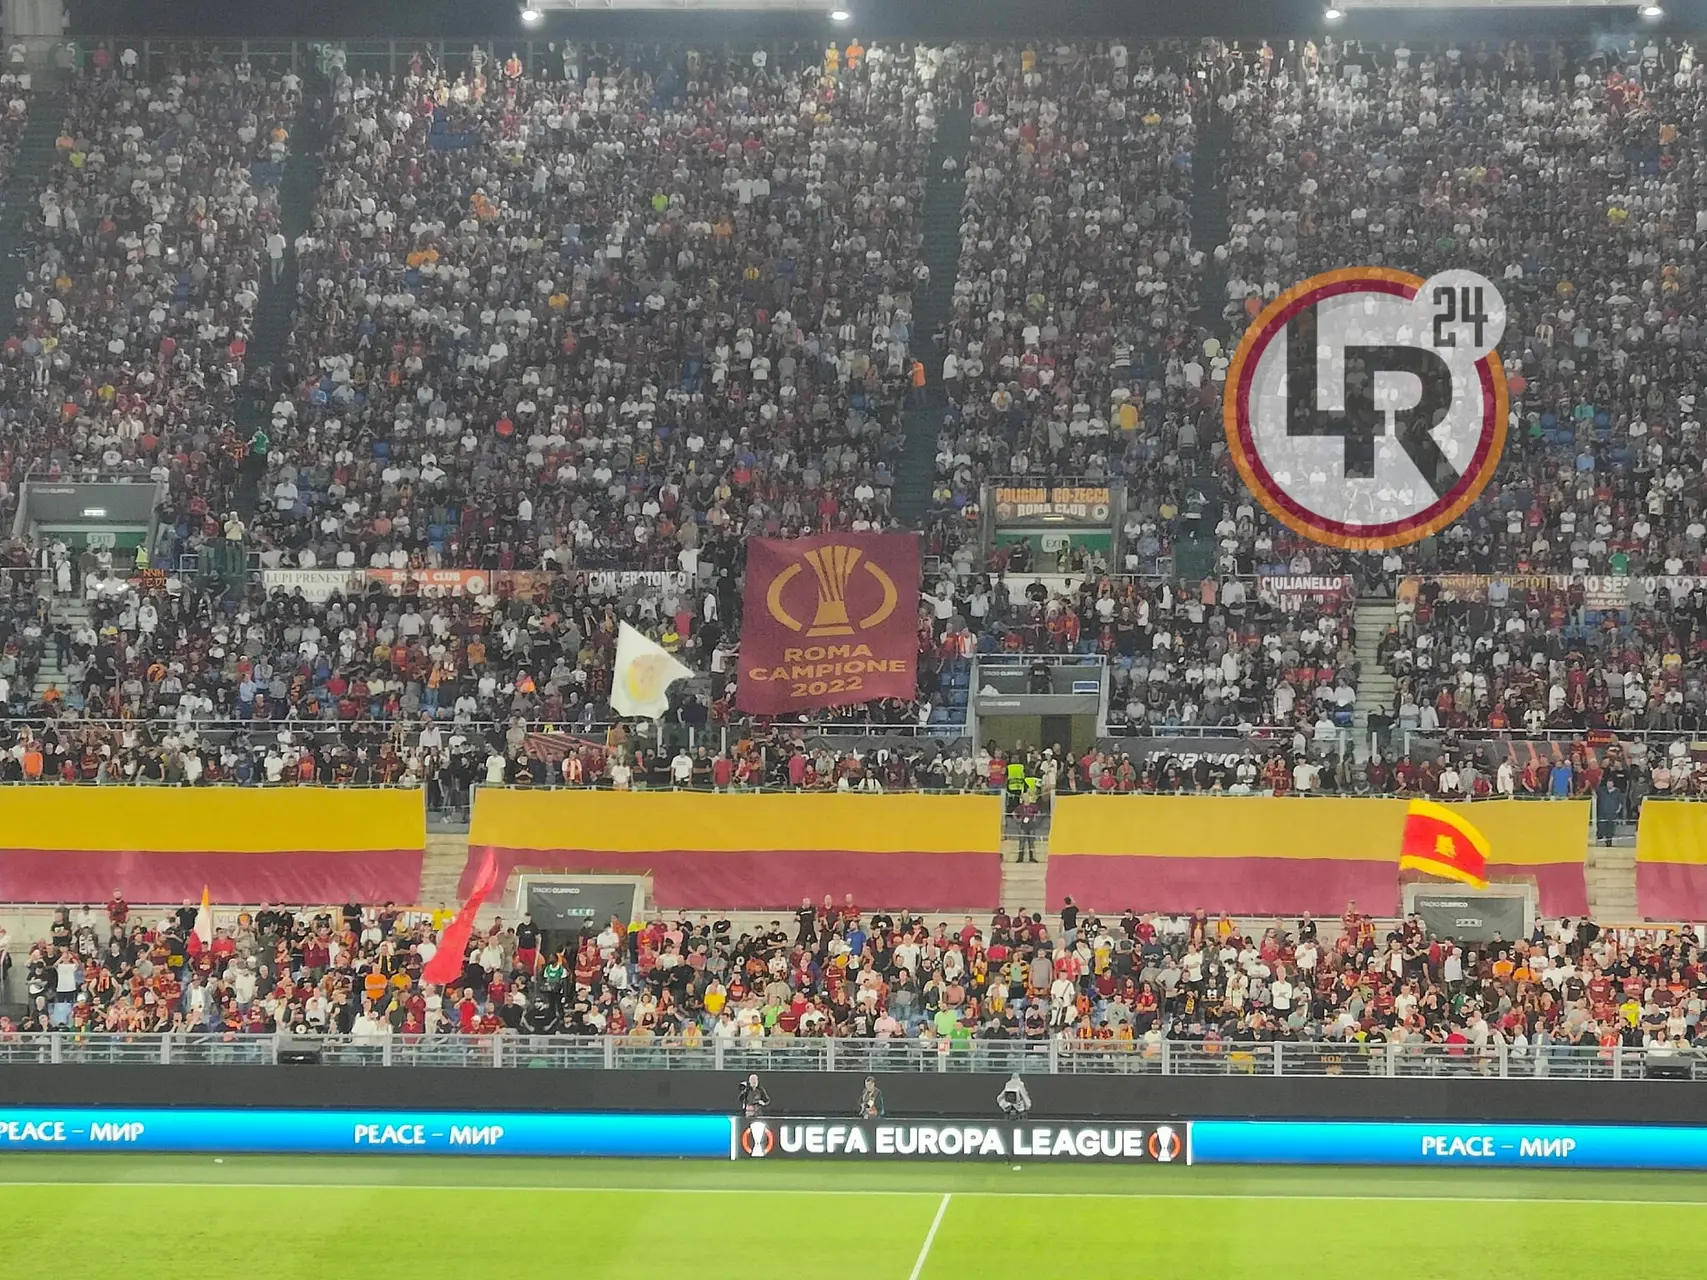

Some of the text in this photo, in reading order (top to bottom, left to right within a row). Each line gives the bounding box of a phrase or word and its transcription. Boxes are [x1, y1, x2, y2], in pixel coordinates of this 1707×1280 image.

[1017, 503, 1086, 517] ROMA CLUB
[91, 535, 112, 545] EXIT
[433, 572, 460, 581] CLUB
[784, 644, 873, 663] ROMA
[748, 660, 907, 682] CAMPIONE
[790, 676, 863, 698] 2022
[0, 1121, 67, 1141] PEACE
[90, 1122, 145, 1141] МИР
[354, 1124, 426, 1145] PEACE
[449, 1125, 504, 1145] МИР
[779, 1125, 1143, 1157] UEFA EUROPA LEAGUE
[1422, 1135, 1496, 1157] PEACE
[1519, 1137, 1576, 1157] МИР
